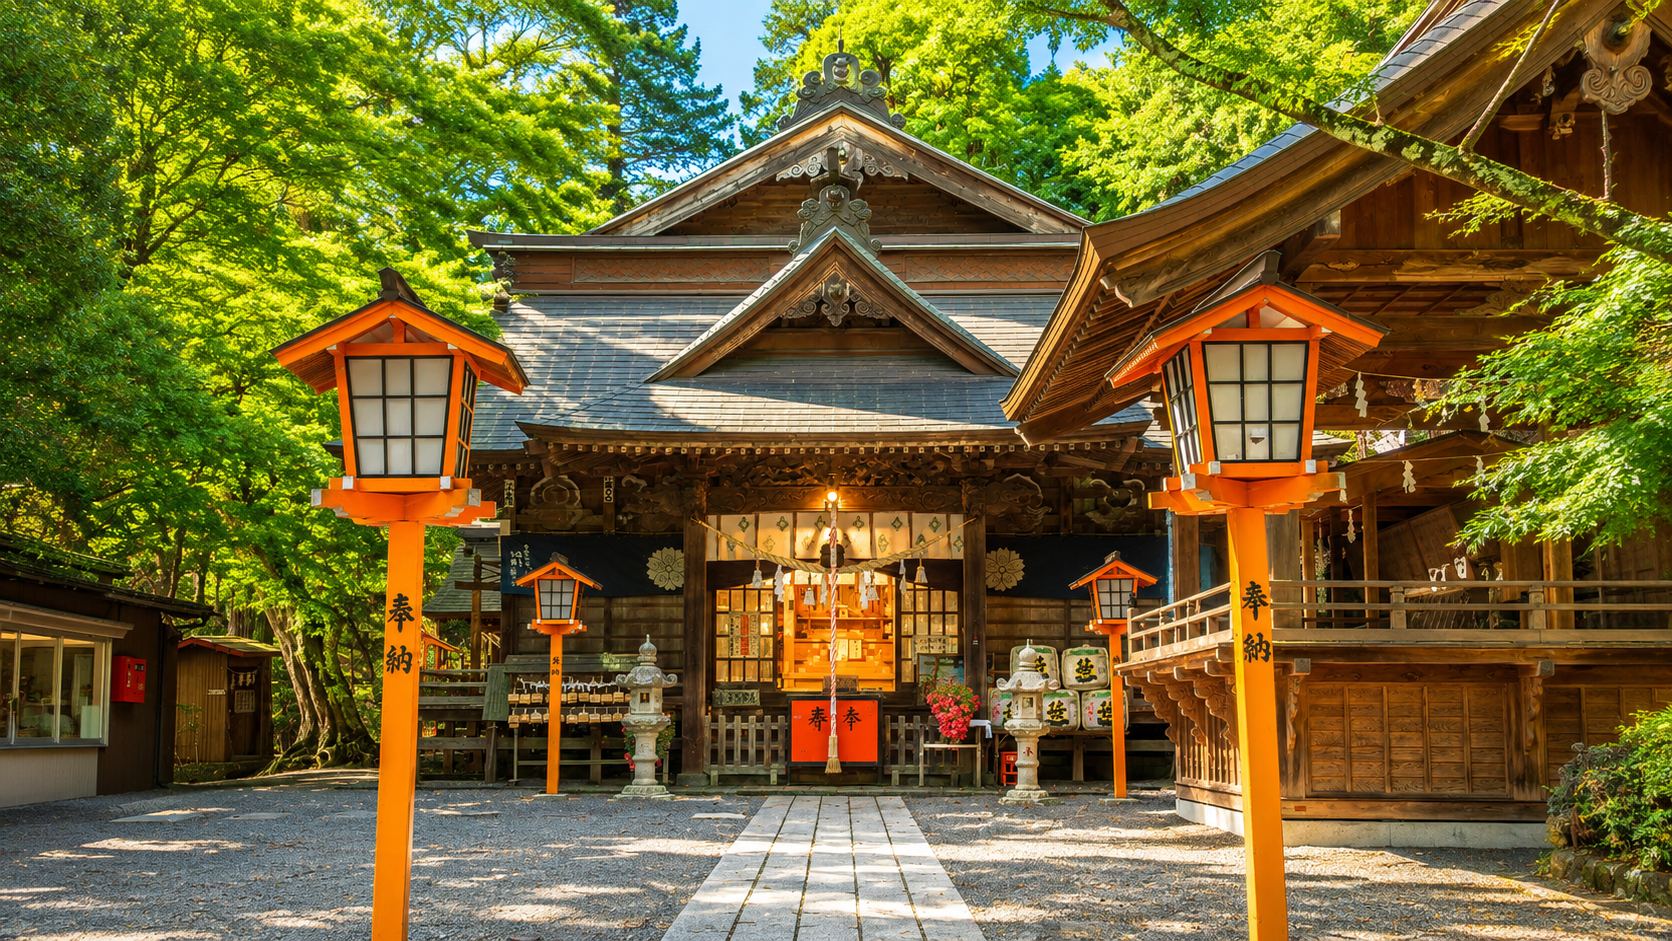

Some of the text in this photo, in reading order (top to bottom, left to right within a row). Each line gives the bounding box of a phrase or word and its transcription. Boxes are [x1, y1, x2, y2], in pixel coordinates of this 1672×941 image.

[386, 593, 415, 674] 奉納
[1241, 580, 1271, 663] 奉納
[842, 706, 862, 731] 奉
